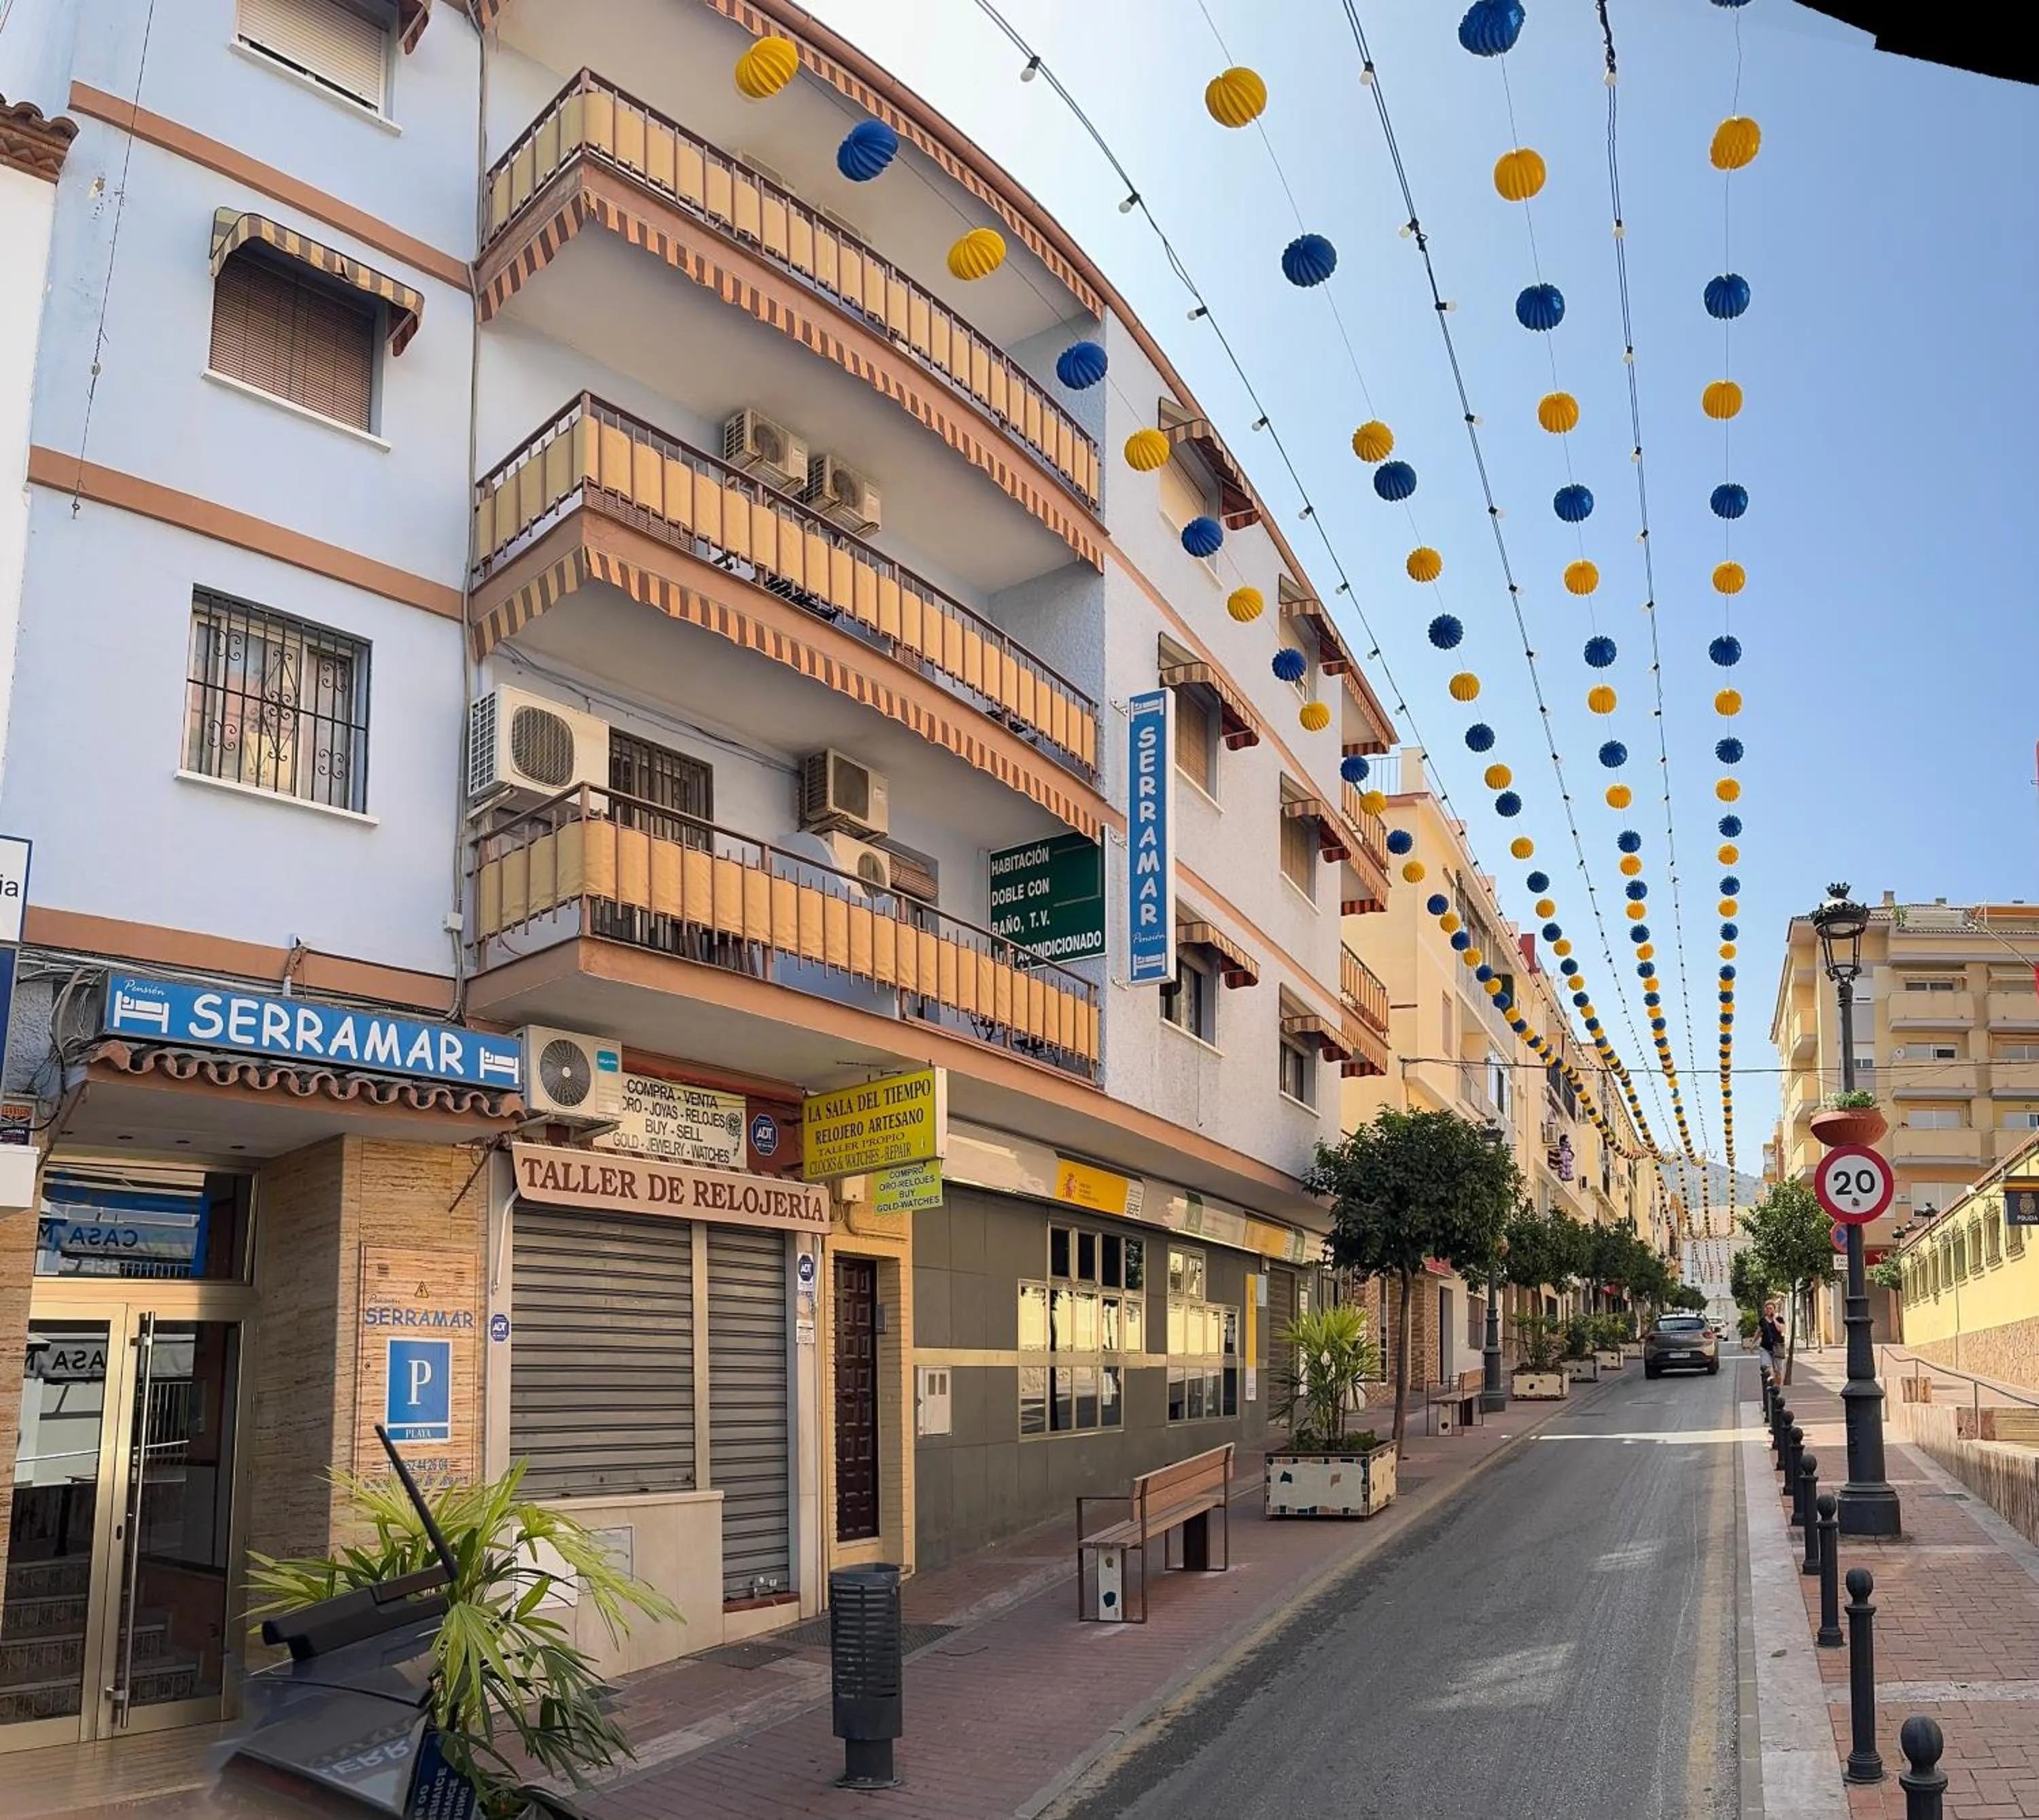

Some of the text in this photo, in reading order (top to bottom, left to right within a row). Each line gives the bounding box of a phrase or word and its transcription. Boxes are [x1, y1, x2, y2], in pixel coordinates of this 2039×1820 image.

[1137, 727, 1160, 926] SERRAMAR
[992, 845, 1049, 876] HABITACIÓN
[992, 878, 1049, 907] DOBLE CON
[992, 910, 1050, 936] BAÑO, T.V.
[1132, 932, 1166, 944] Pensión
[124, 979, 164, 996] Pensión
[189, 994, 464, 1075] SERRAMAR
[627, 1079, 676, 1102] COMPRA
[683, 1090, 718, 1109] VENTA
[808, 1079, 930, 1123] LA SALA DEL TIEMPO
[649, 1102, 678, 1120] JOYAS
[686, 1108, 725, 1128] RELOJES
[816, 1107, 924, 1145] RELOJERO ARTESANO
[646, 1119, 668, 1136] BUY
[676, 1125, 703, 1142] SELL
[756, 1127, 773, 1140] ADT
[613, 1132, 640, 1149] GOLD
[646, 1138, 684, 1155] JEWELRY
[691, 1145, 729, 1163] WATCHES
[819, 1132, 905, 1156] TALLER PROPIO
[845, 1147, 879, 1168] WATCHES
[885, 1142, 911, 1160] REPAIR
[879, 1174, 935, 1191] ORO-RELOJES
[889, 1166, 924, 1178] COMPRO
[1833, 1170, 1875, 1195] 20
[522, 1157, 824, 1222] TALLER DE RELOJERÍA
[899, 1190, 916, 1198] BUY
[876, 1195, 940, 1212] GOLD-WATCHES
[365, 1308, 474, 1327] SERRAMAR
[492, 1322, 506, 1331] ADT
[407, 1359, 432, 1405] P
[406, 1428, 432, 1439] PLAYA
